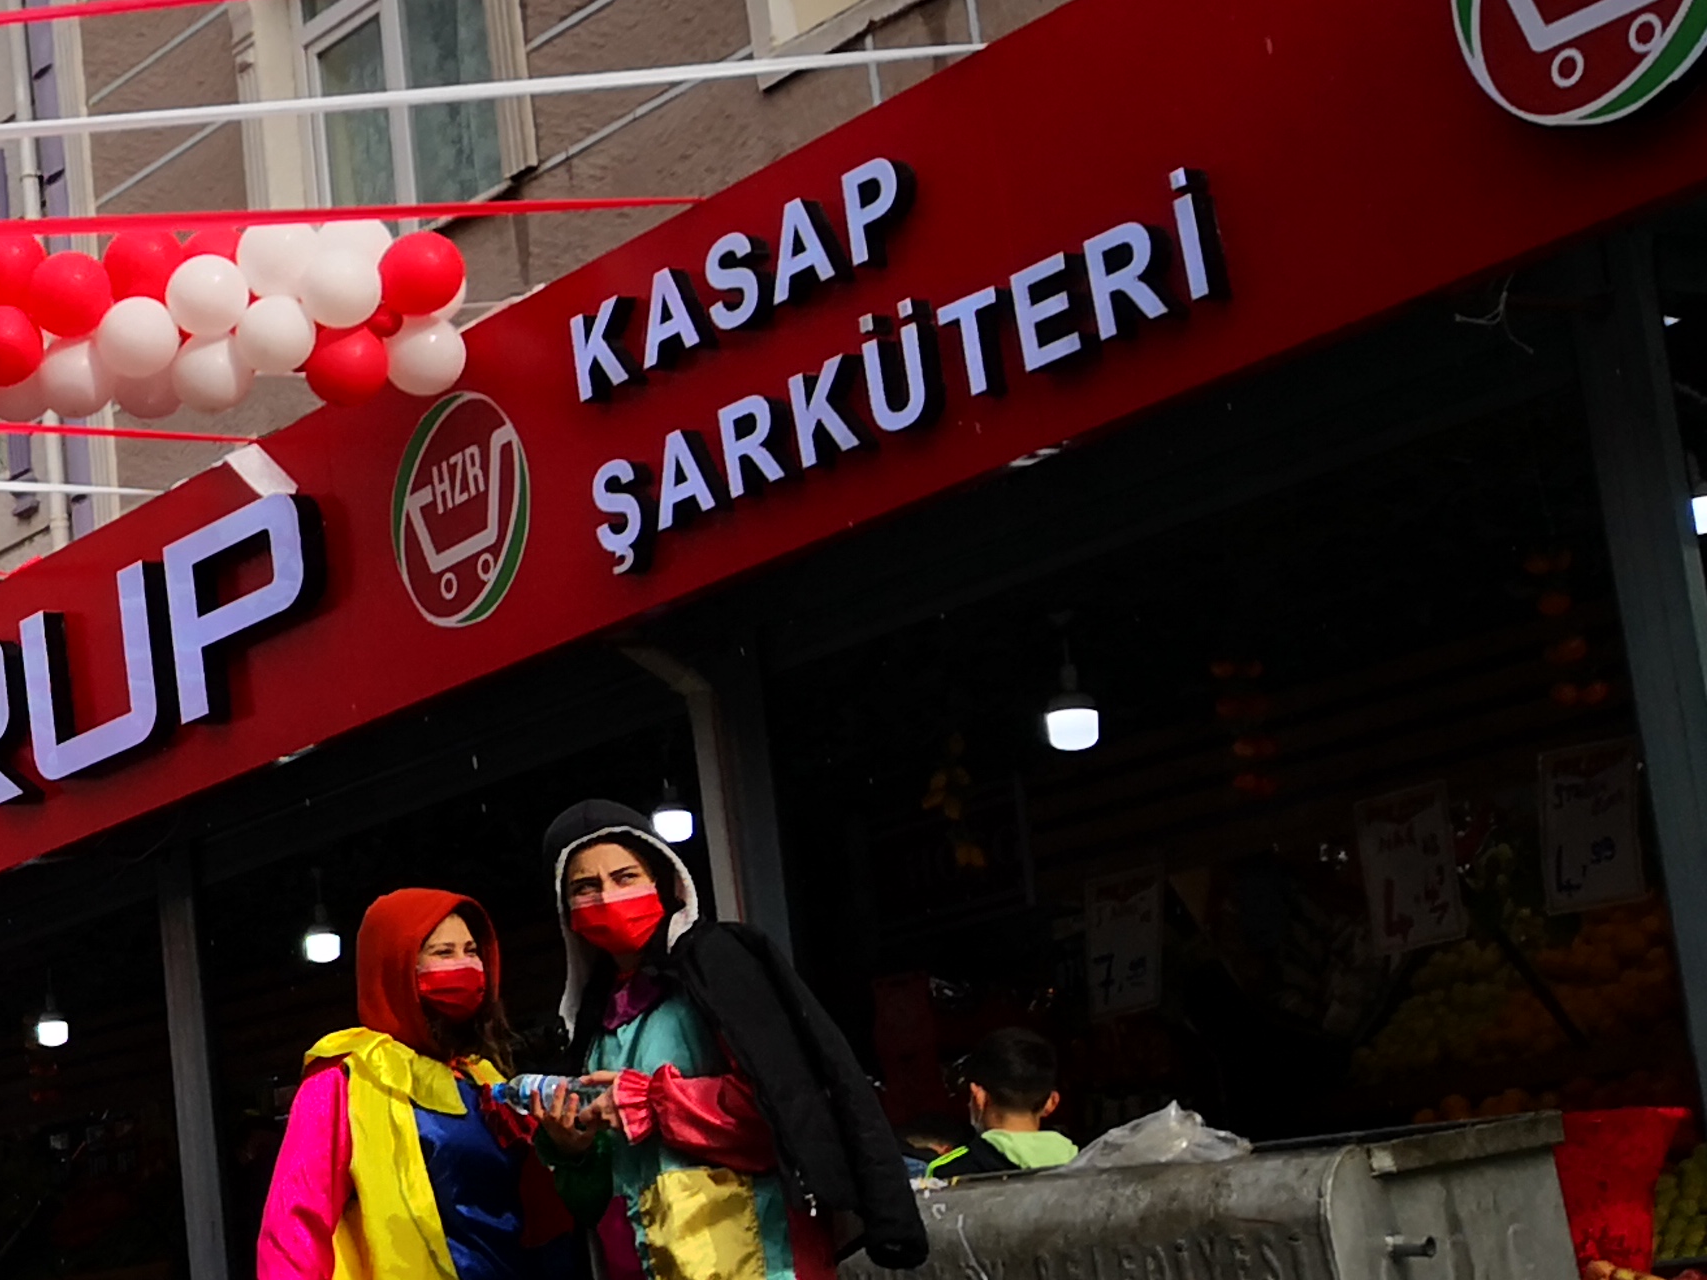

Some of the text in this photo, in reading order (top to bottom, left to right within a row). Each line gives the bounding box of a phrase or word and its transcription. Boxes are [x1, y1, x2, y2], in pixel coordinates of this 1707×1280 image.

[570, 157, 897, 401] KASAP
[592, 167, 1209, 574] ŞARKÜTERİ
[431, 444, 485, 514] HZR
